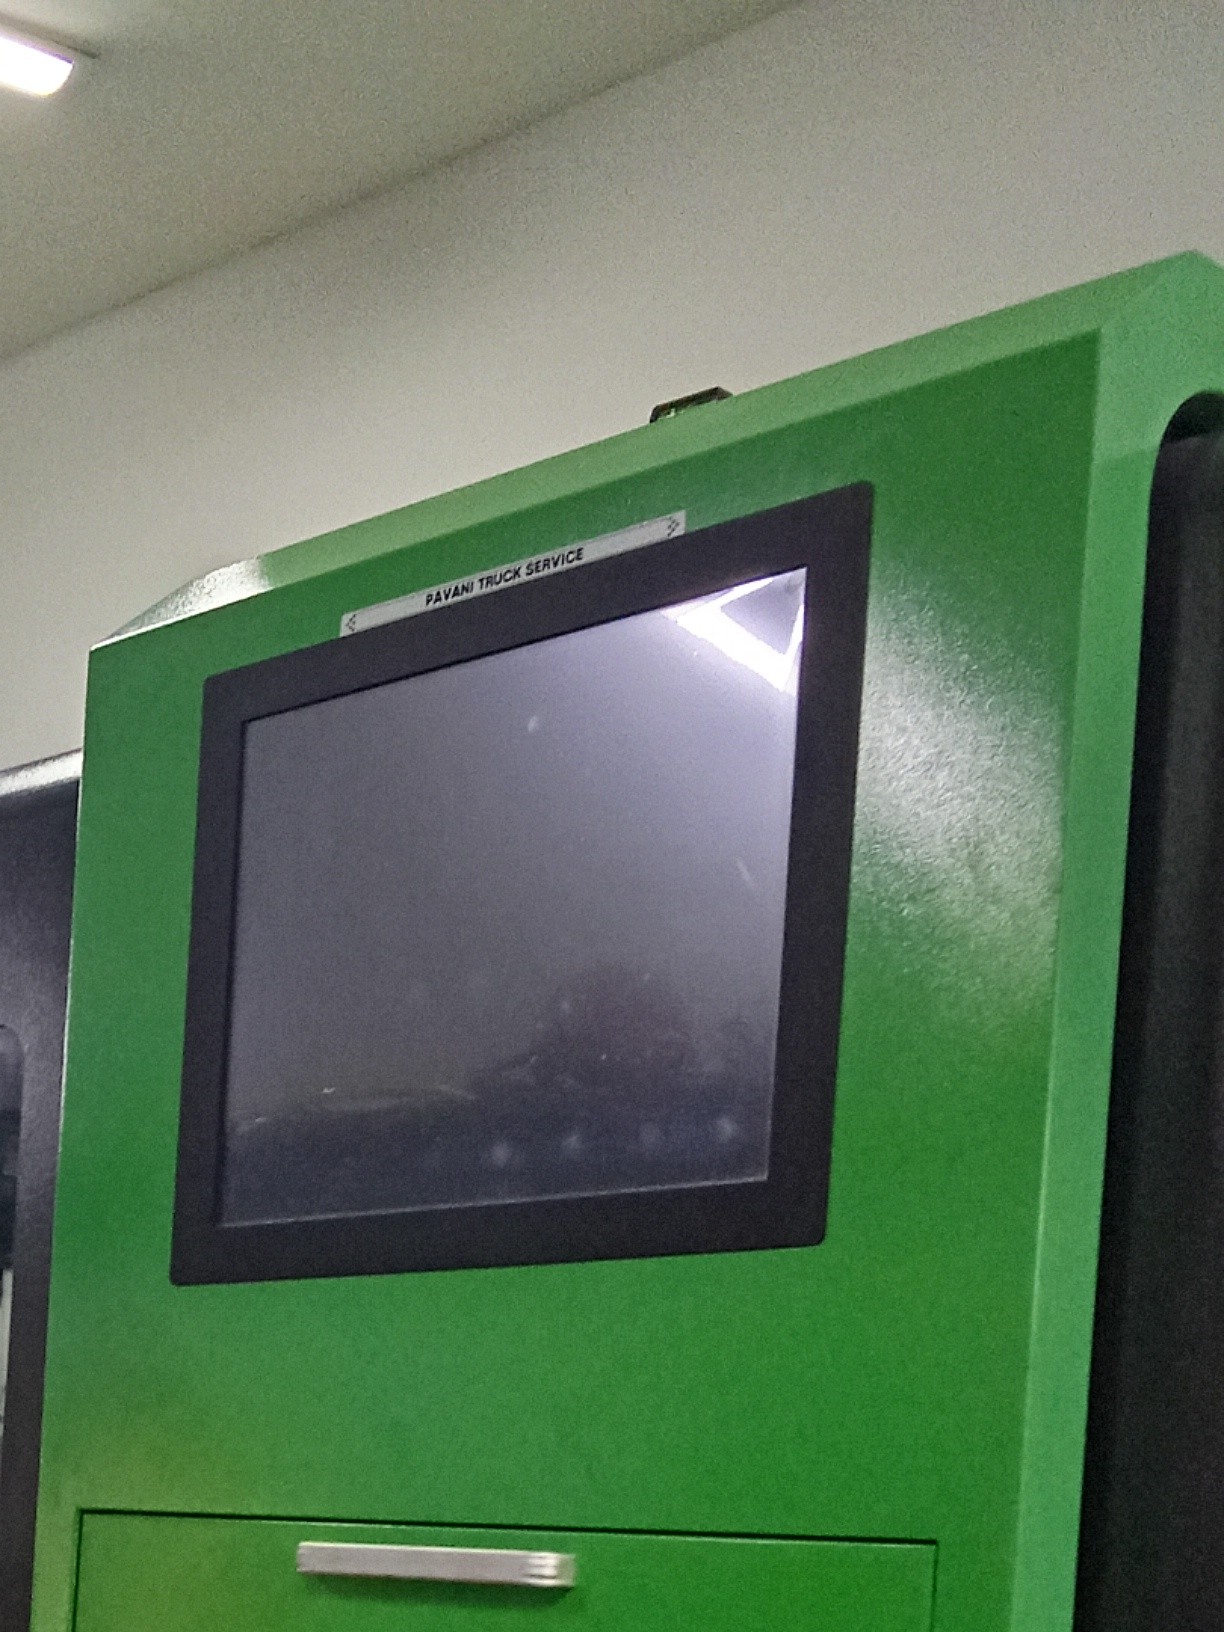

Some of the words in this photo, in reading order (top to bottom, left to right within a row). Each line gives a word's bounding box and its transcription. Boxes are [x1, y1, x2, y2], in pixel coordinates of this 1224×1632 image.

[426, 582, 474, 605] PAVANI
[478, 566, 521, 590] TRUCK
[525, 548, 584, 576] SERVICE
